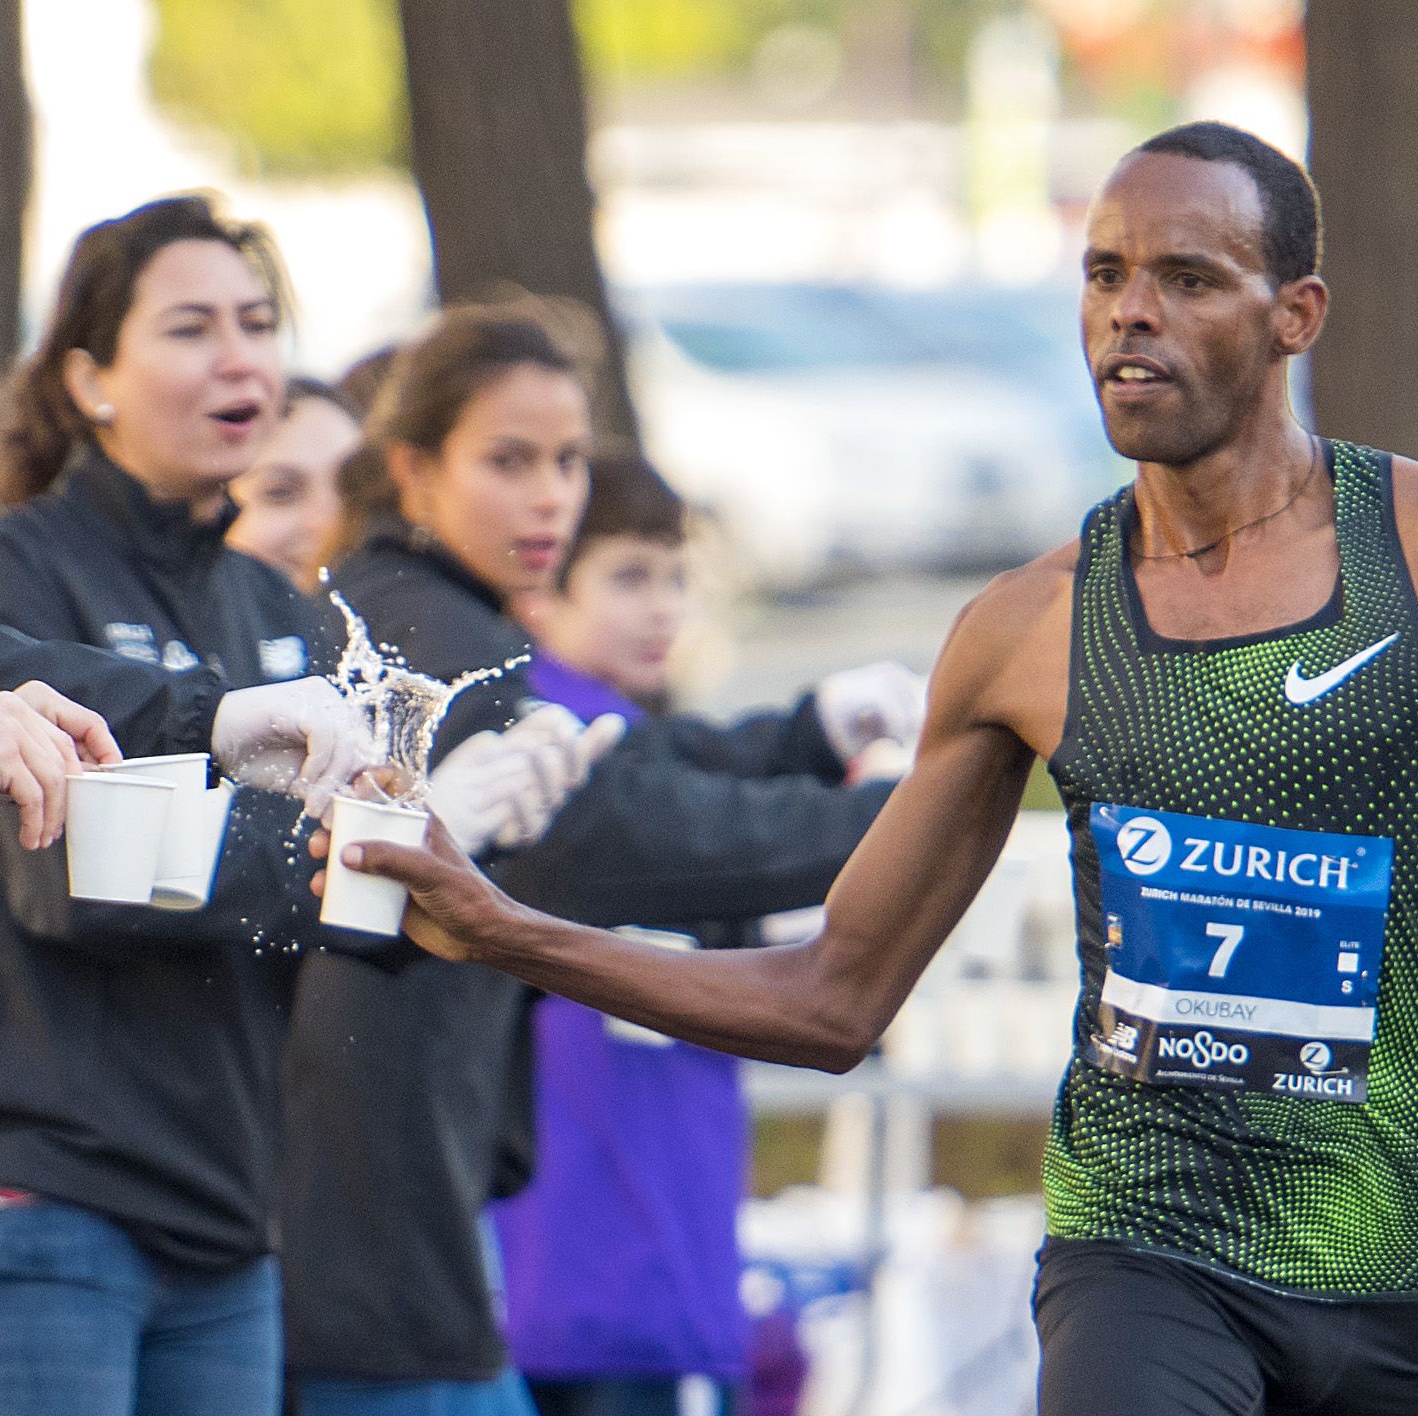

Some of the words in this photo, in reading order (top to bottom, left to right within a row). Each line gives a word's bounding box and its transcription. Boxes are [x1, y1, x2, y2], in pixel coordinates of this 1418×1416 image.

[1180, 837, 1349, 890] ZURICH
[1140, 886, 1179, 902] ZURICH
[1180, 890, 1234, 909] MARATÓN
[1236, 897, 1252, 910] DE
[1252, 900, 1293, 916] SEVILLA
[1295, 906, 1322, 920] 2019
[1205, 922, 1245, 978] 7
[1341, 980, 1353, 994] S
[1175, 998, 1258, 1021] OKUBAY
[1272, 1073, 1353, 1096] ZURICH
